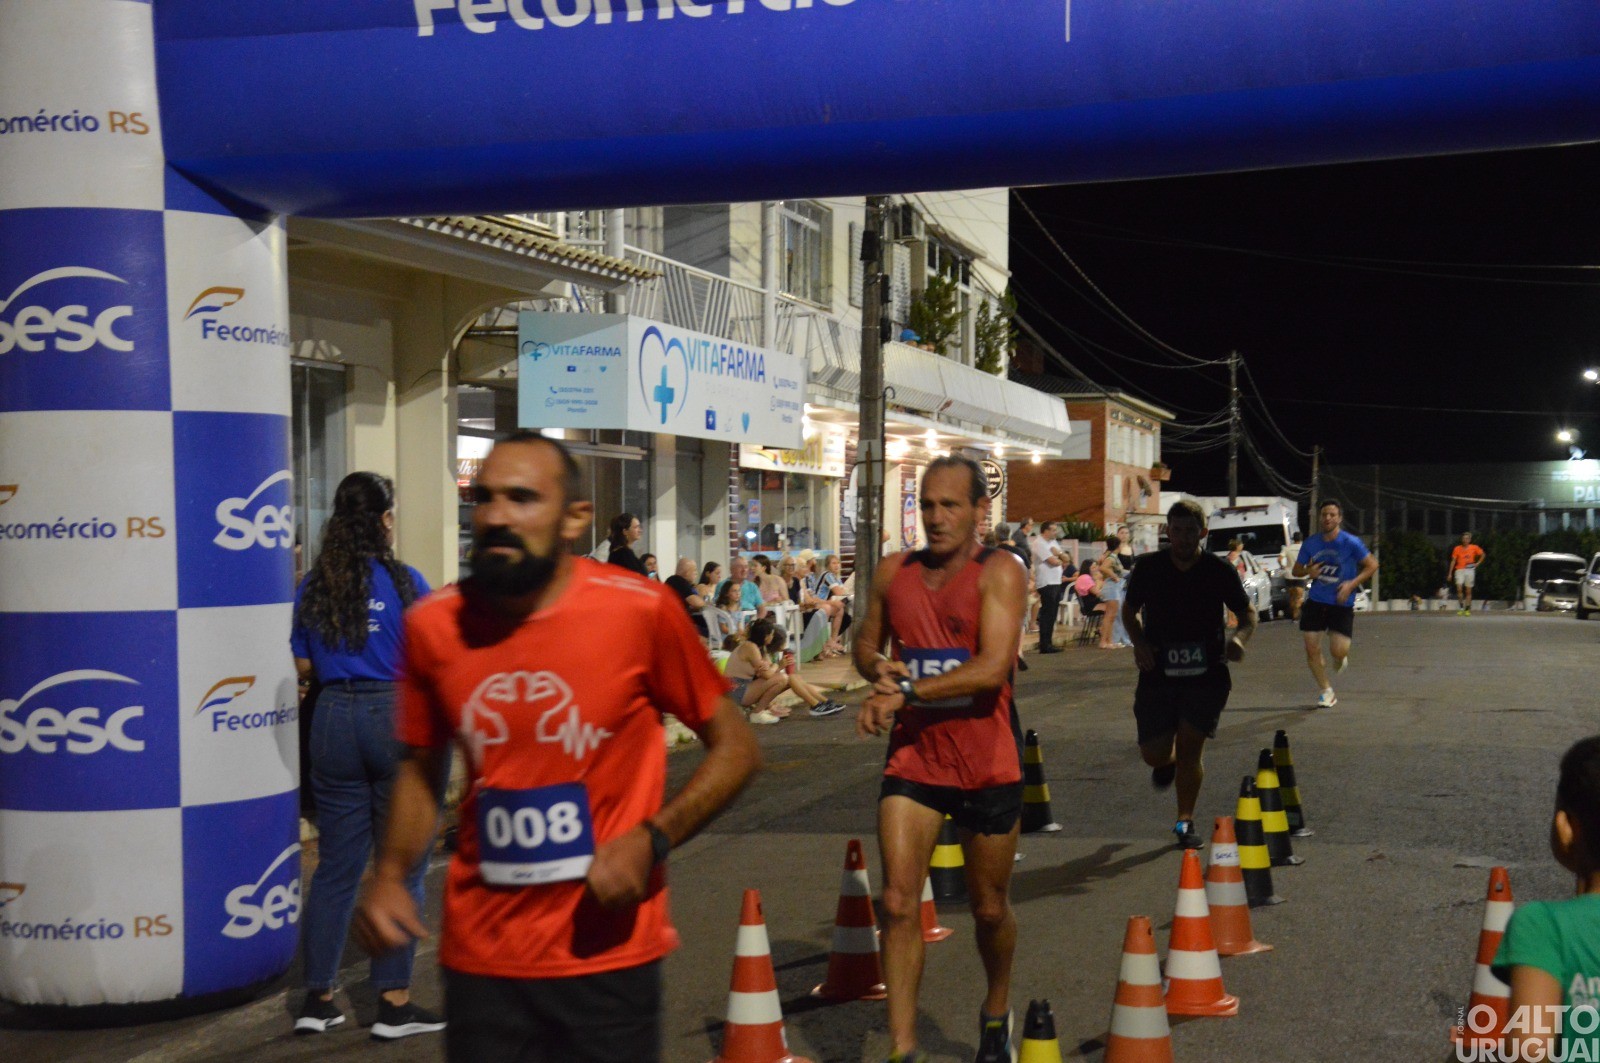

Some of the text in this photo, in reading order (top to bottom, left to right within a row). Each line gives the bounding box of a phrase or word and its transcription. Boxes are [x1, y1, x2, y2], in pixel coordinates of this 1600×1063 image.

[108, 111, 150, 135] RS
[552, 345, 622, 357] VITAFARMA
[686, 336, 766, 384] VITAFARMA
[1573, 485, 1600, 502] PA
[126, 516, 166, 538] RS
[1168, 648, 1203, 664] 034
[486, 801, 583, 848] 008
[134, 914, 174, 938] RS
